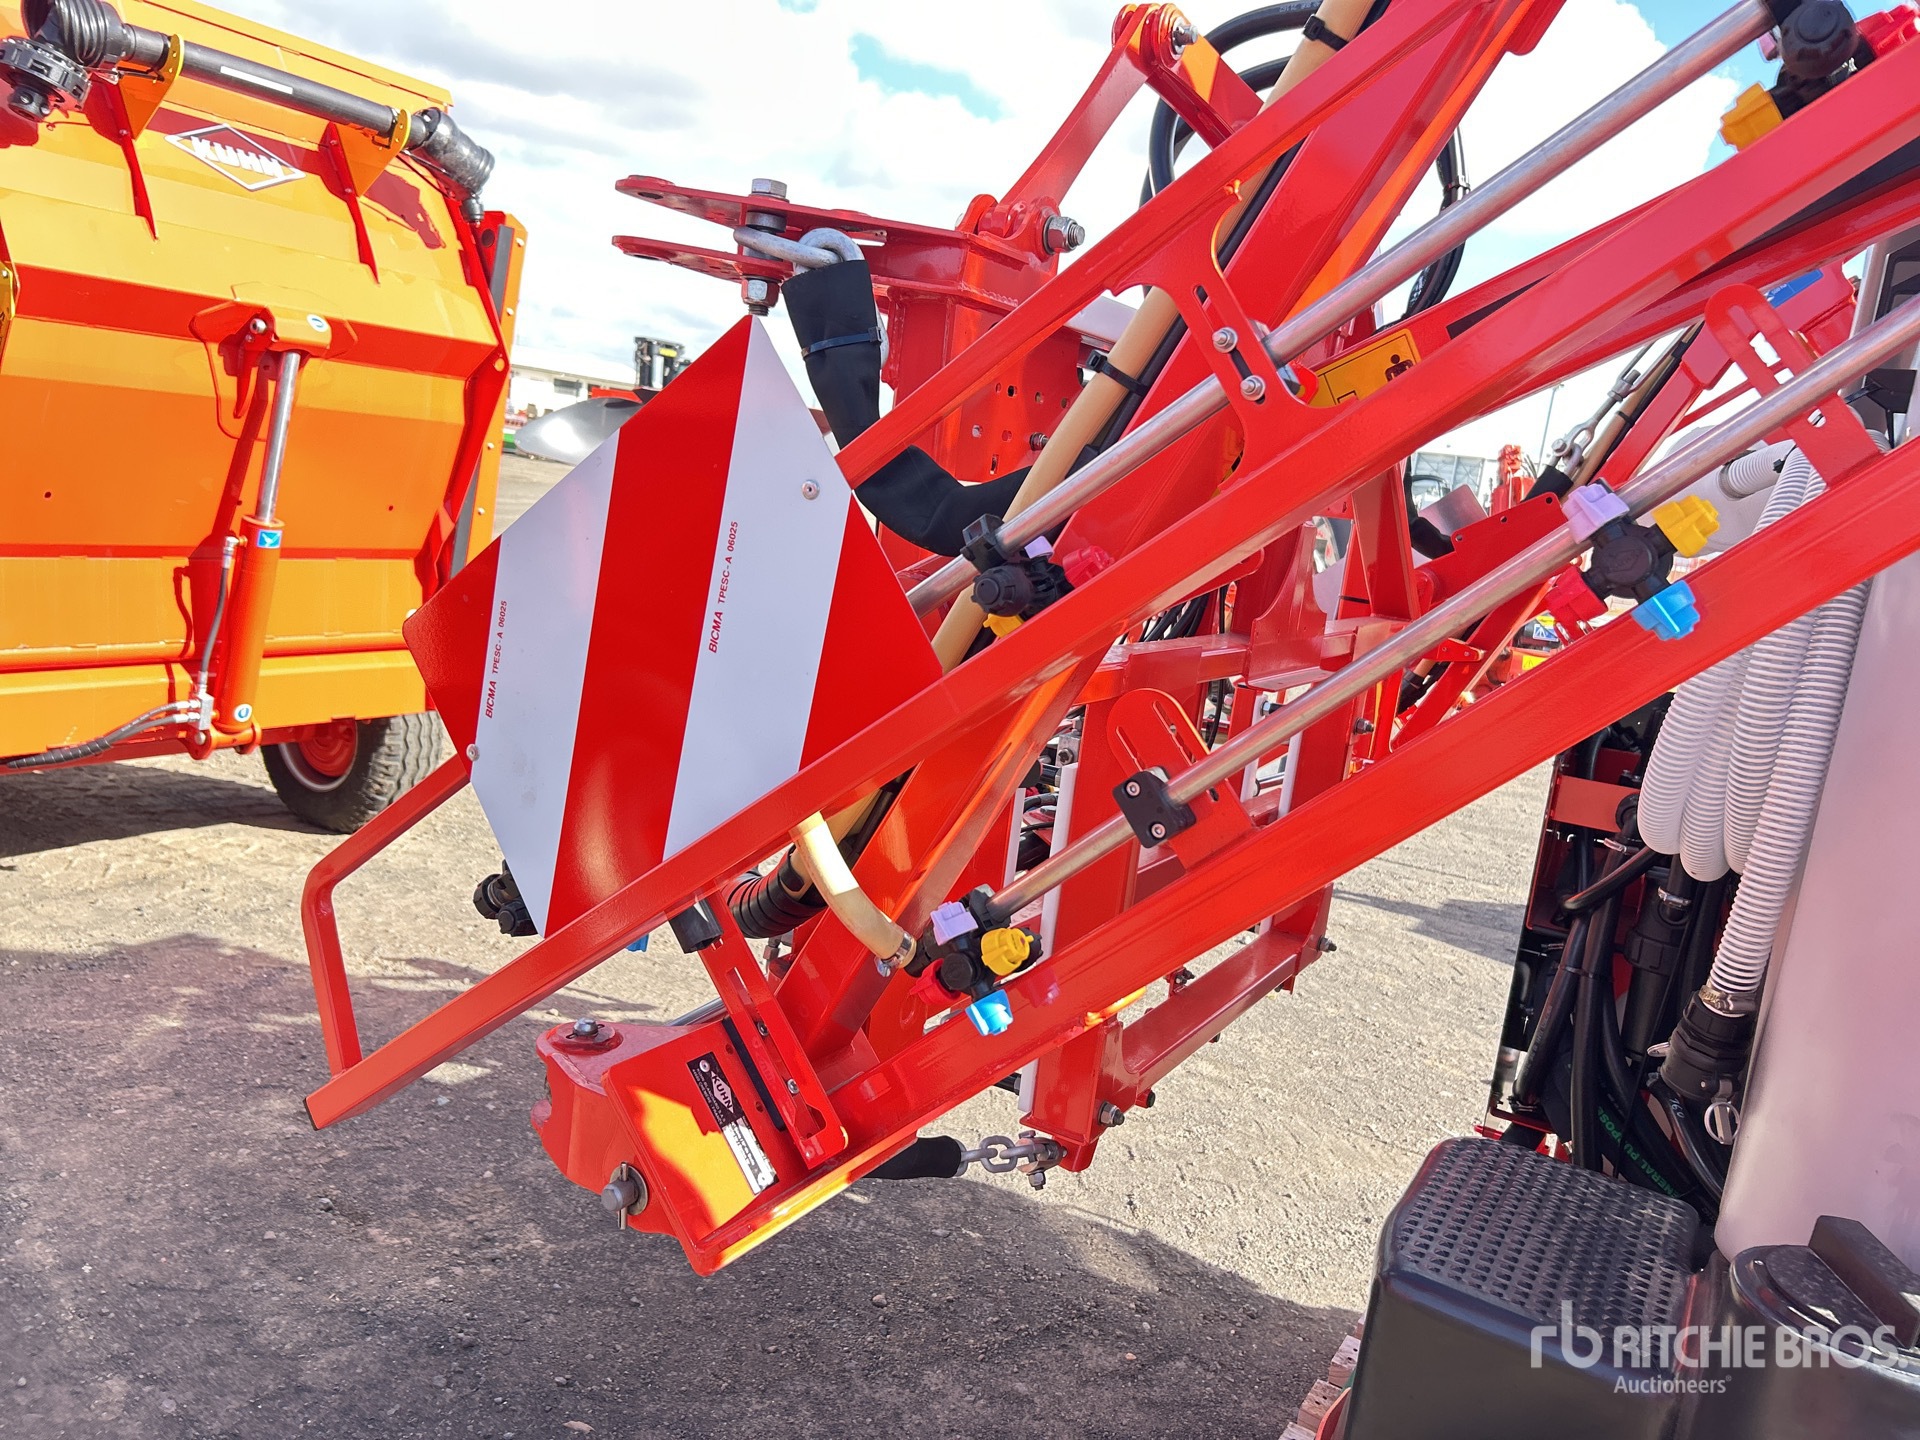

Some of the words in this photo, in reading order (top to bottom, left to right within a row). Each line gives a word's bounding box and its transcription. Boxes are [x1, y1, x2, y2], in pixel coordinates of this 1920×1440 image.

[190, 136, 285, 178] KUHN
[708, 611, 723, 653] BICMA
[726, 521, 738, 552] 06025
[485, 680, 497, 719] BICMA
[498, 600, 507, 628] 06025
[711, 1075, 733, 1109] KUHN
